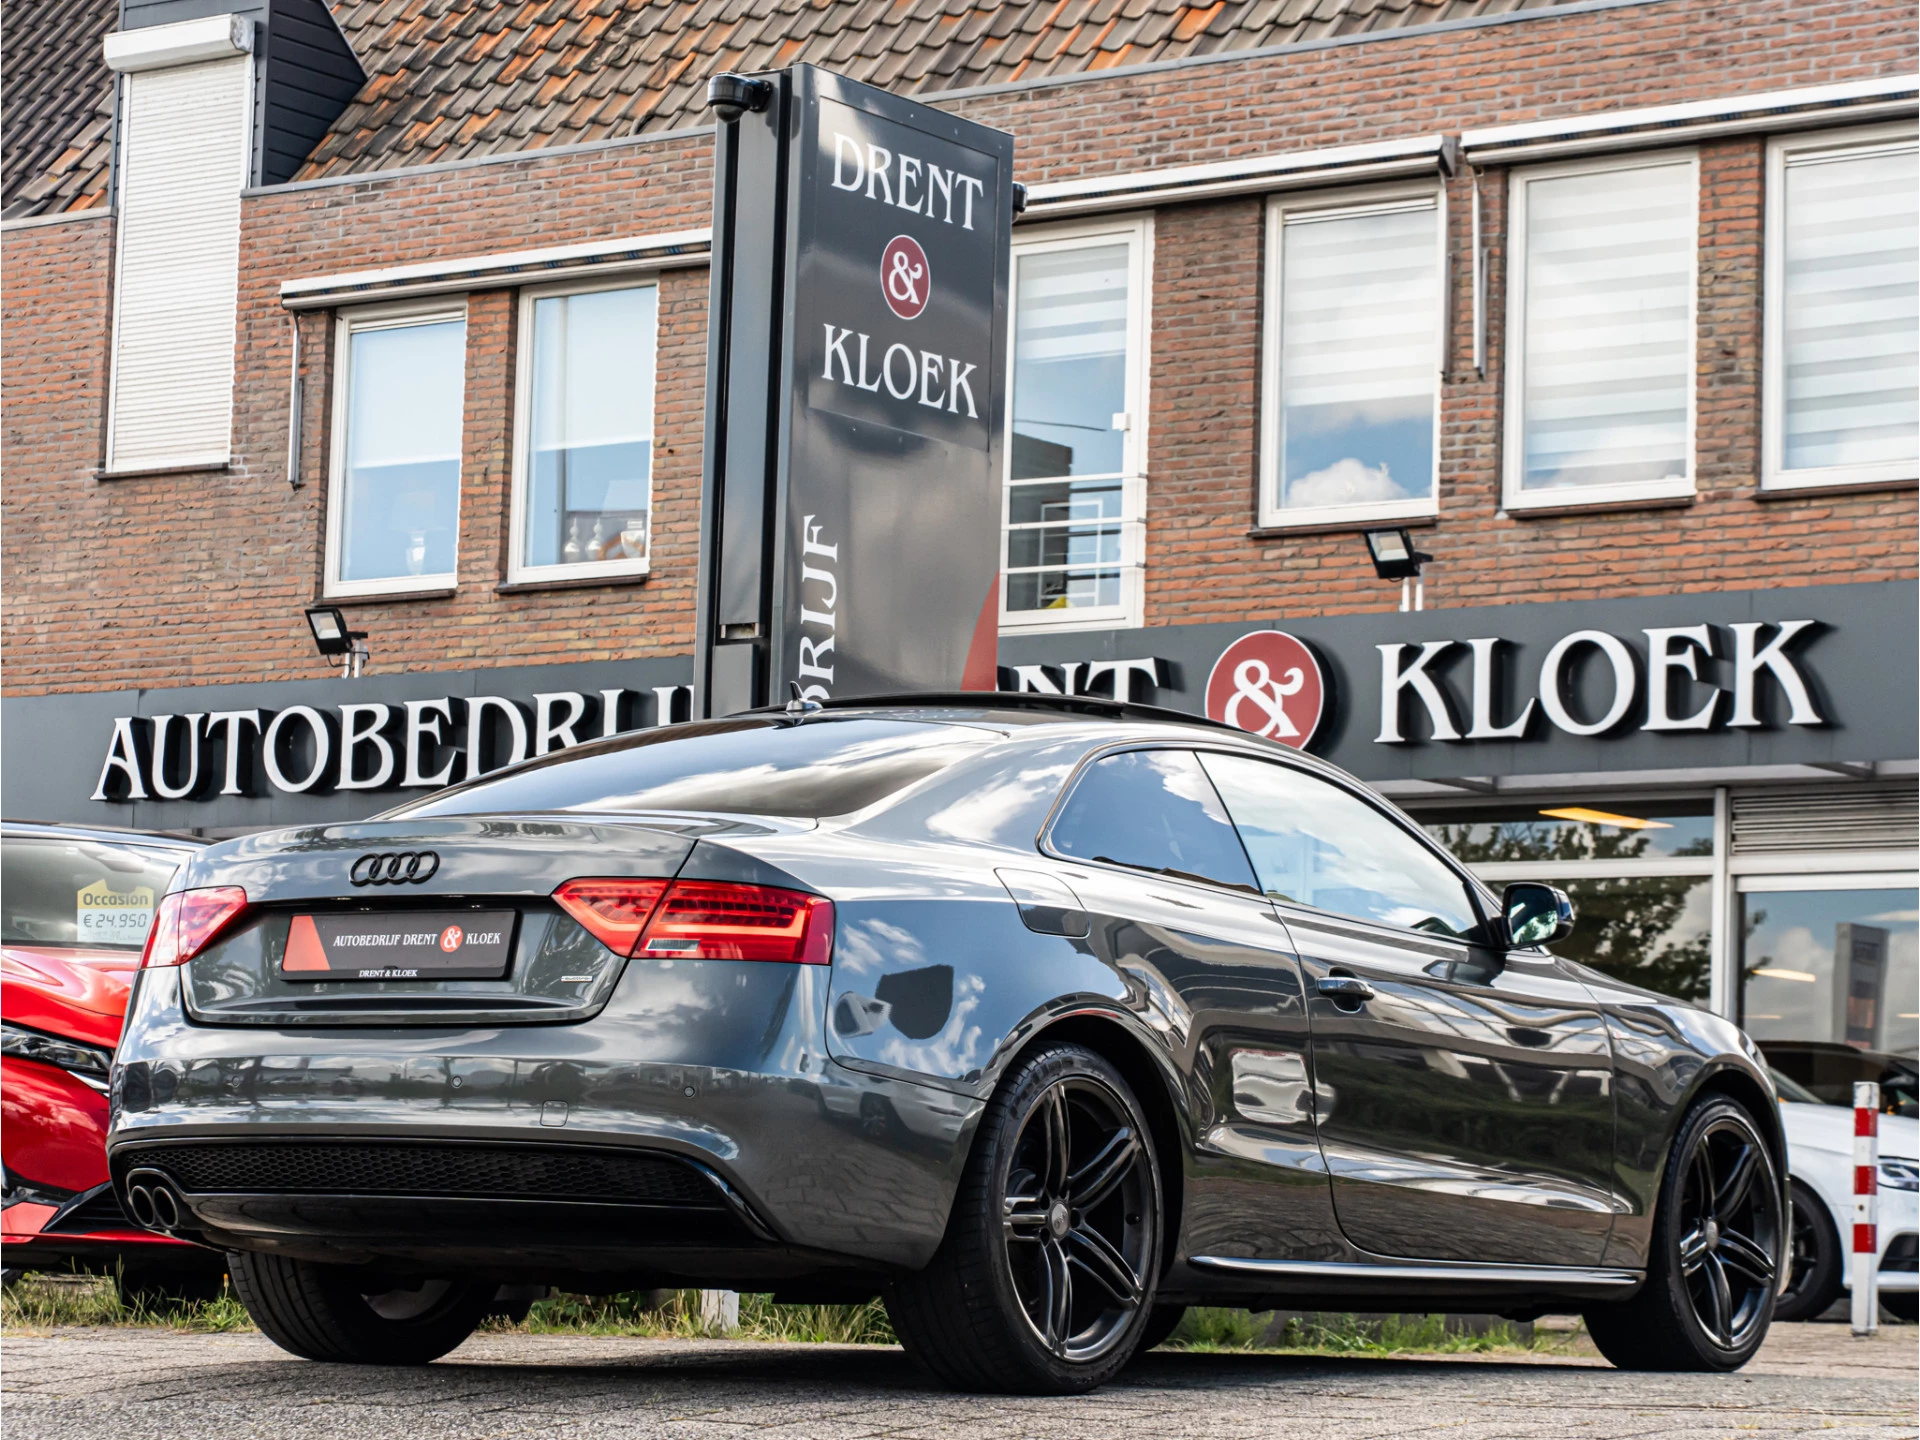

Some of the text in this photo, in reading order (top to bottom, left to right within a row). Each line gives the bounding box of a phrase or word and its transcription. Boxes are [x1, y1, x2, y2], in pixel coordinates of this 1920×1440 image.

[831, 132, 984, 231] DRENT
[888, 251, 923, 305] &
[821, 323, 979, 419] KLOEK
[1225, 659, 1304, 738] &
[1376, 620, 1824, 744] KLOEK
[83, 893, 148, 906] Occasion
[333, 928, 501, 948] AUTOBEDRIJF DRENT & KLOEK
[358, 969, 418, 978] DRENT & KLOEK
